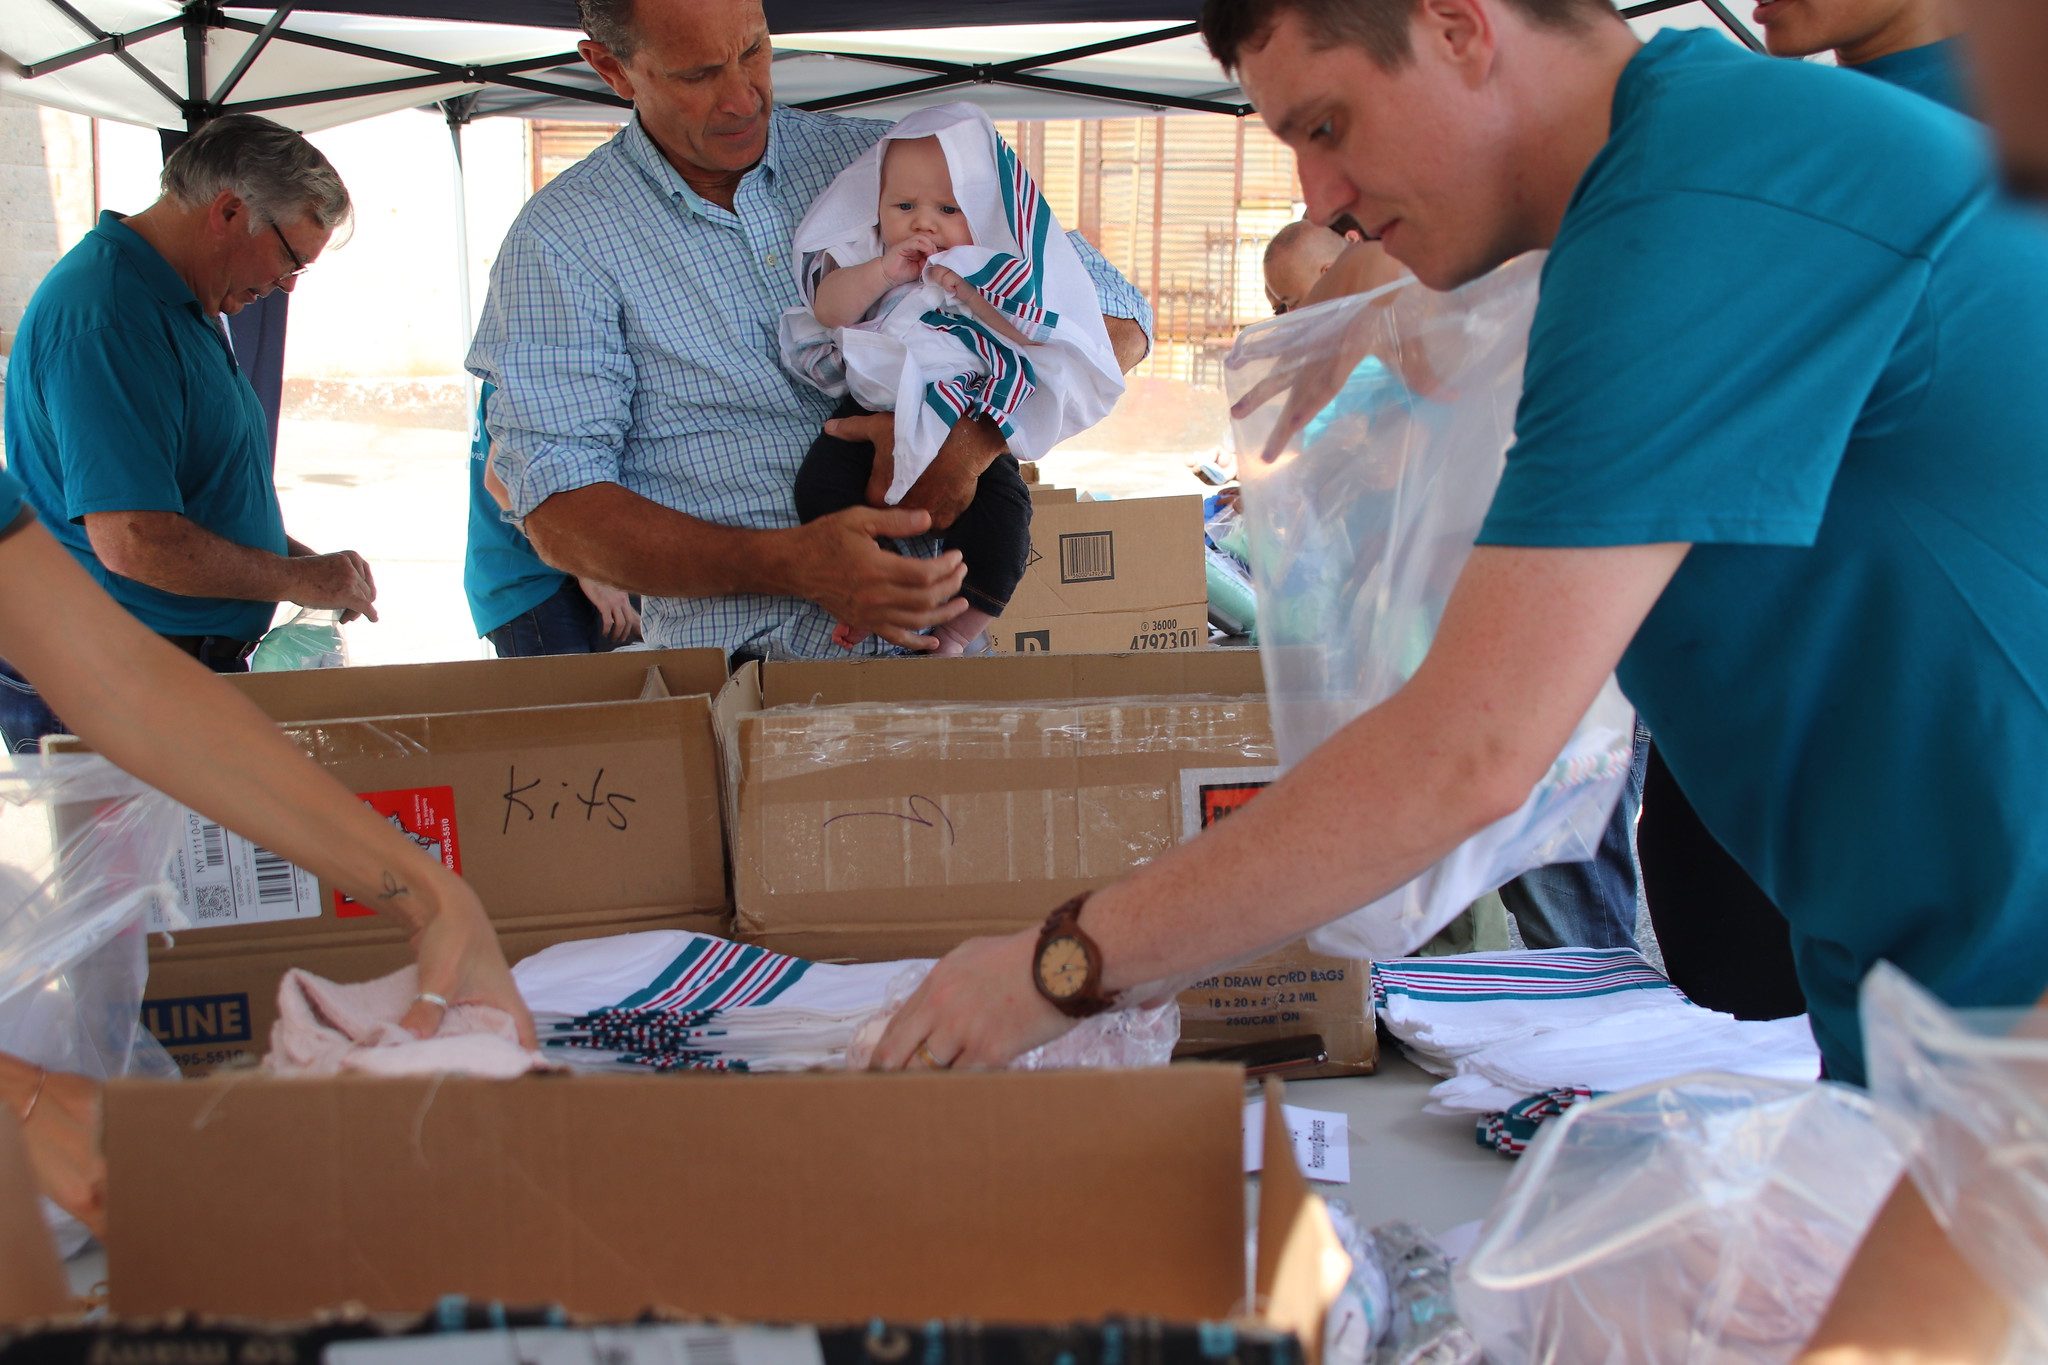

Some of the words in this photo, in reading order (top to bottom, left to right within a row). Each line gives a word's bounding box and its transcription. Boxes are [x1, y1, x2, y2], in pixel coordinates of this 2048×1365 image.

[1152, 619, 1177, 631] 36000
[503, 765, 637, 835] Kits
[1224, 976, 1263, 988] DRAW
[1267, 971, 1307, 986] CORD
[1310, 969, 1345, 982] BAGS
[1208, 998, 1221, 1009] 18
[1234, 997, 1248, 1007] 20
[1278, 993, 1296, 1003] 2.2
[1299, 991, 1318, 1002] MIL
[141, 1000, 242, 1041] LINE
